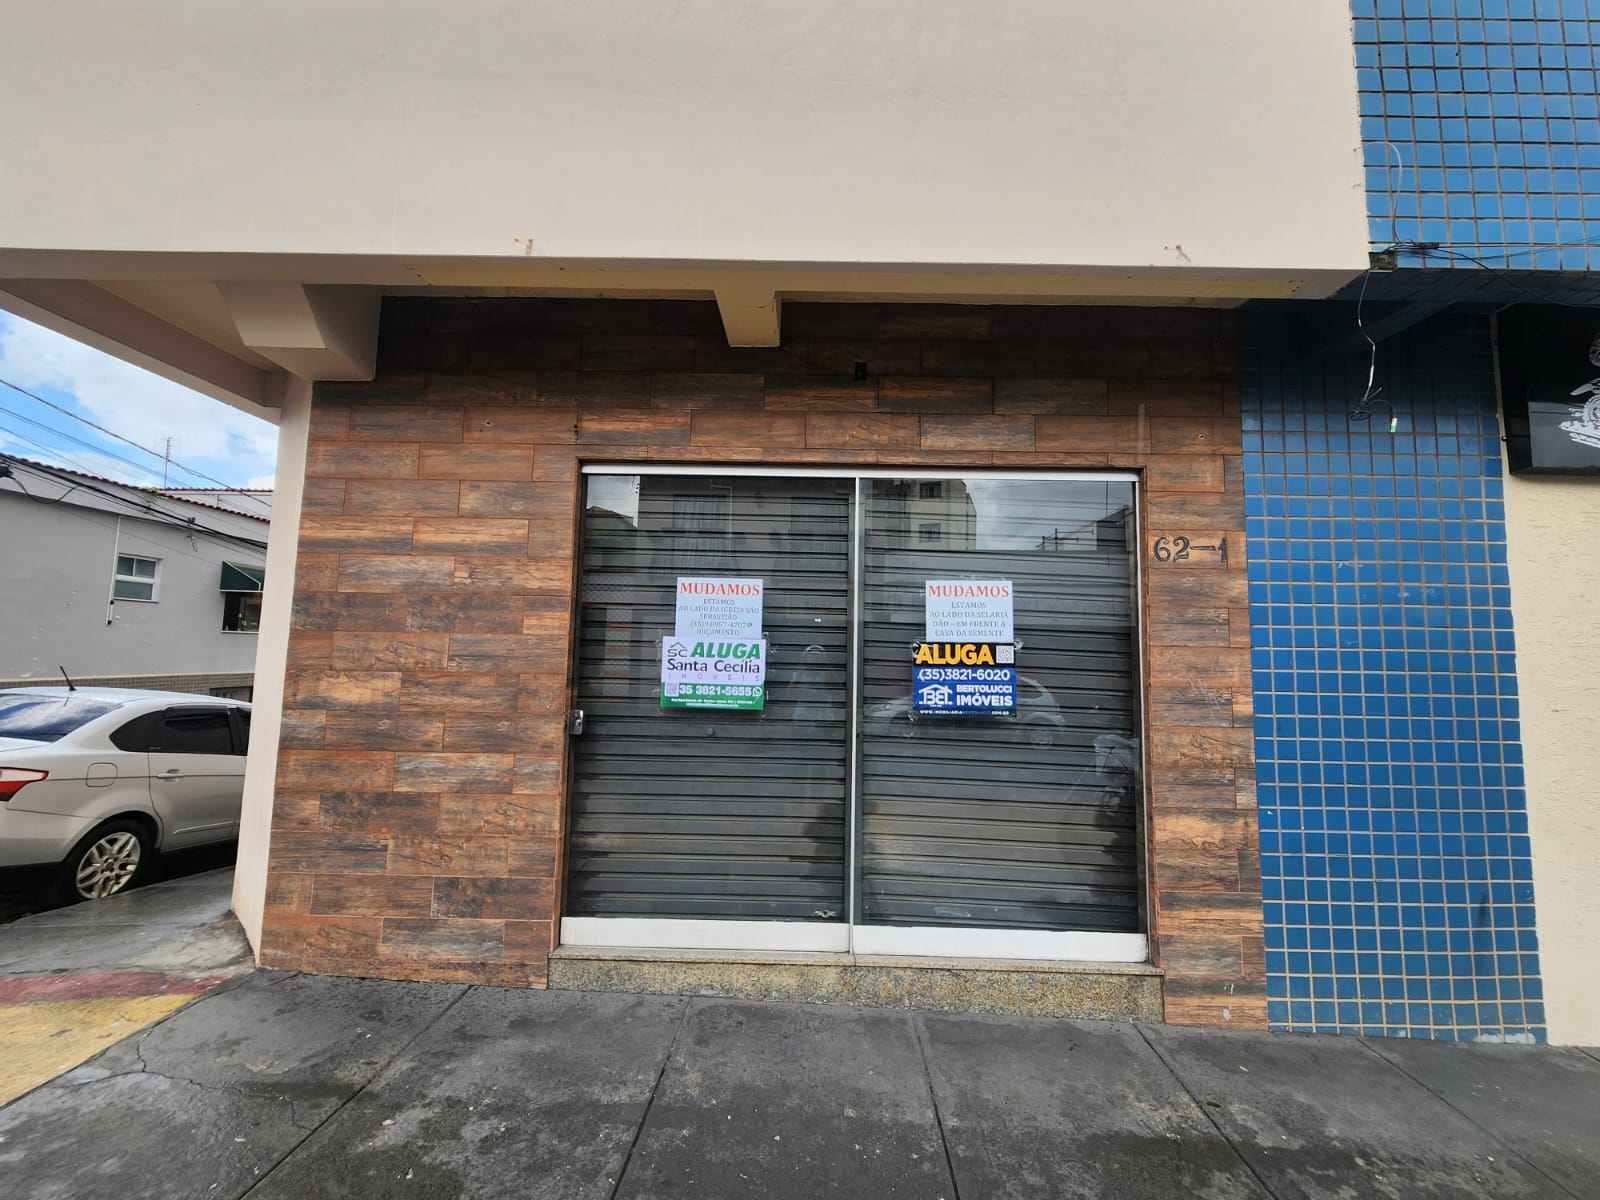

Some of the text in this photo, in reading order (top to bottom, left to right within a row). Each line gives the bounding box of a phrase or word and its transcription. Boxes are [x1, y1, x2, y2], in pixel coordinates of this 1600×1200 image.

[680, 582, 760, 596] MUDAMOS
[929, 585, 1009, 597] MUDAMOS
[690, 642, 760, 659] ALUGA
[916, 644, 994, 664] ALUGA
[667, 659, 760, 674] Santa Cecília
[919, 669, 1010, 681] (35)3821-6020
[679, 685, 752, 695] 35 3821-5655
[956, 685, 1012, 694] BERTOLUCCI
[956, 694, 1012, 706] IMÓVEIS
